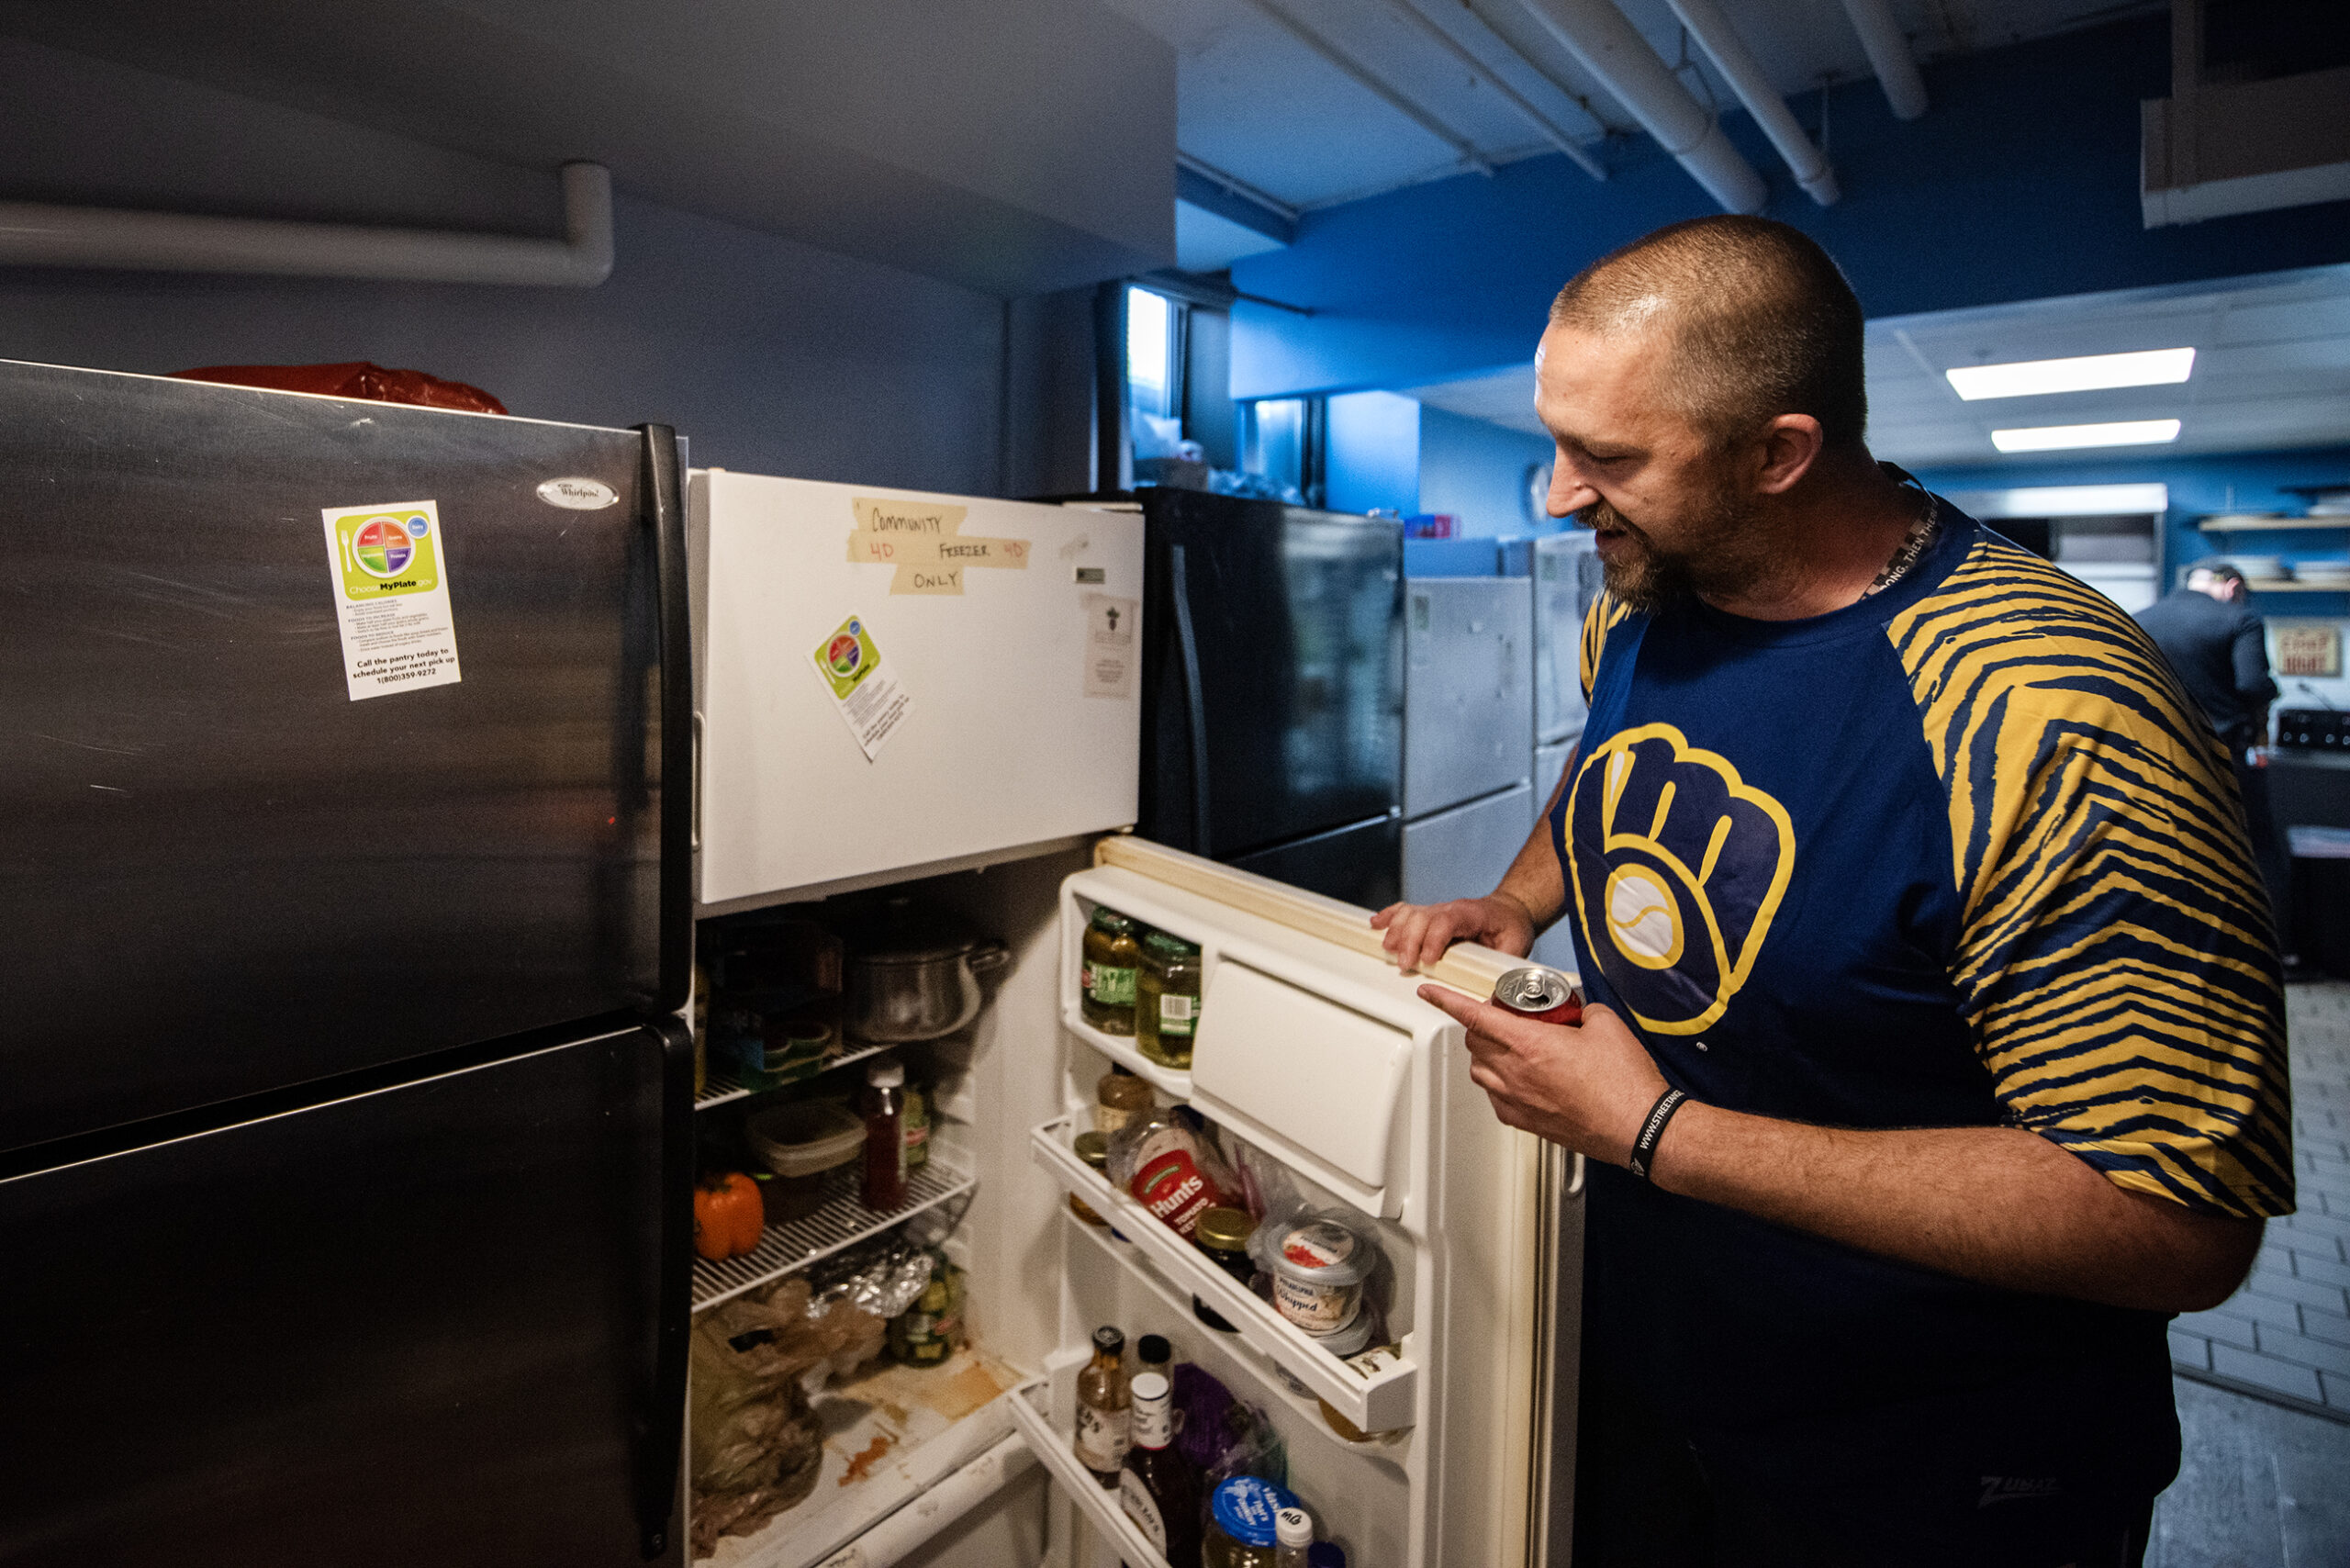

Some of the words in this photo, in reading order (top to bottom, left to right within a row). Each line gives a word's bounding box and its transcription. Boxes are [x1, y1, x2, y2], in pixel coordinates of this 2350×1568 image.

[872, 507, 942, 534] COMMUNITY
[939, 543, 990, 559] FREEZER
[1879, 565, 1908, 590] ONG.
[1904, 537, 1925, 562] THEN
[913, 571, 958, 588] ONLY
[352, 666, 387, 678] schedule
[389, 665, 407, 674] your
[409, 661, 427, 669] next
[429, 656, 443, 666] pick
[445, 656, 455, 665] up
[357, 658, 373, 668] Call
[375, 656, 387, 666] the
[389, 654, 415, 664] pantry
[417, 649, 439, 658] today
[1174, 1197, 1209, 1225] TOMATO
